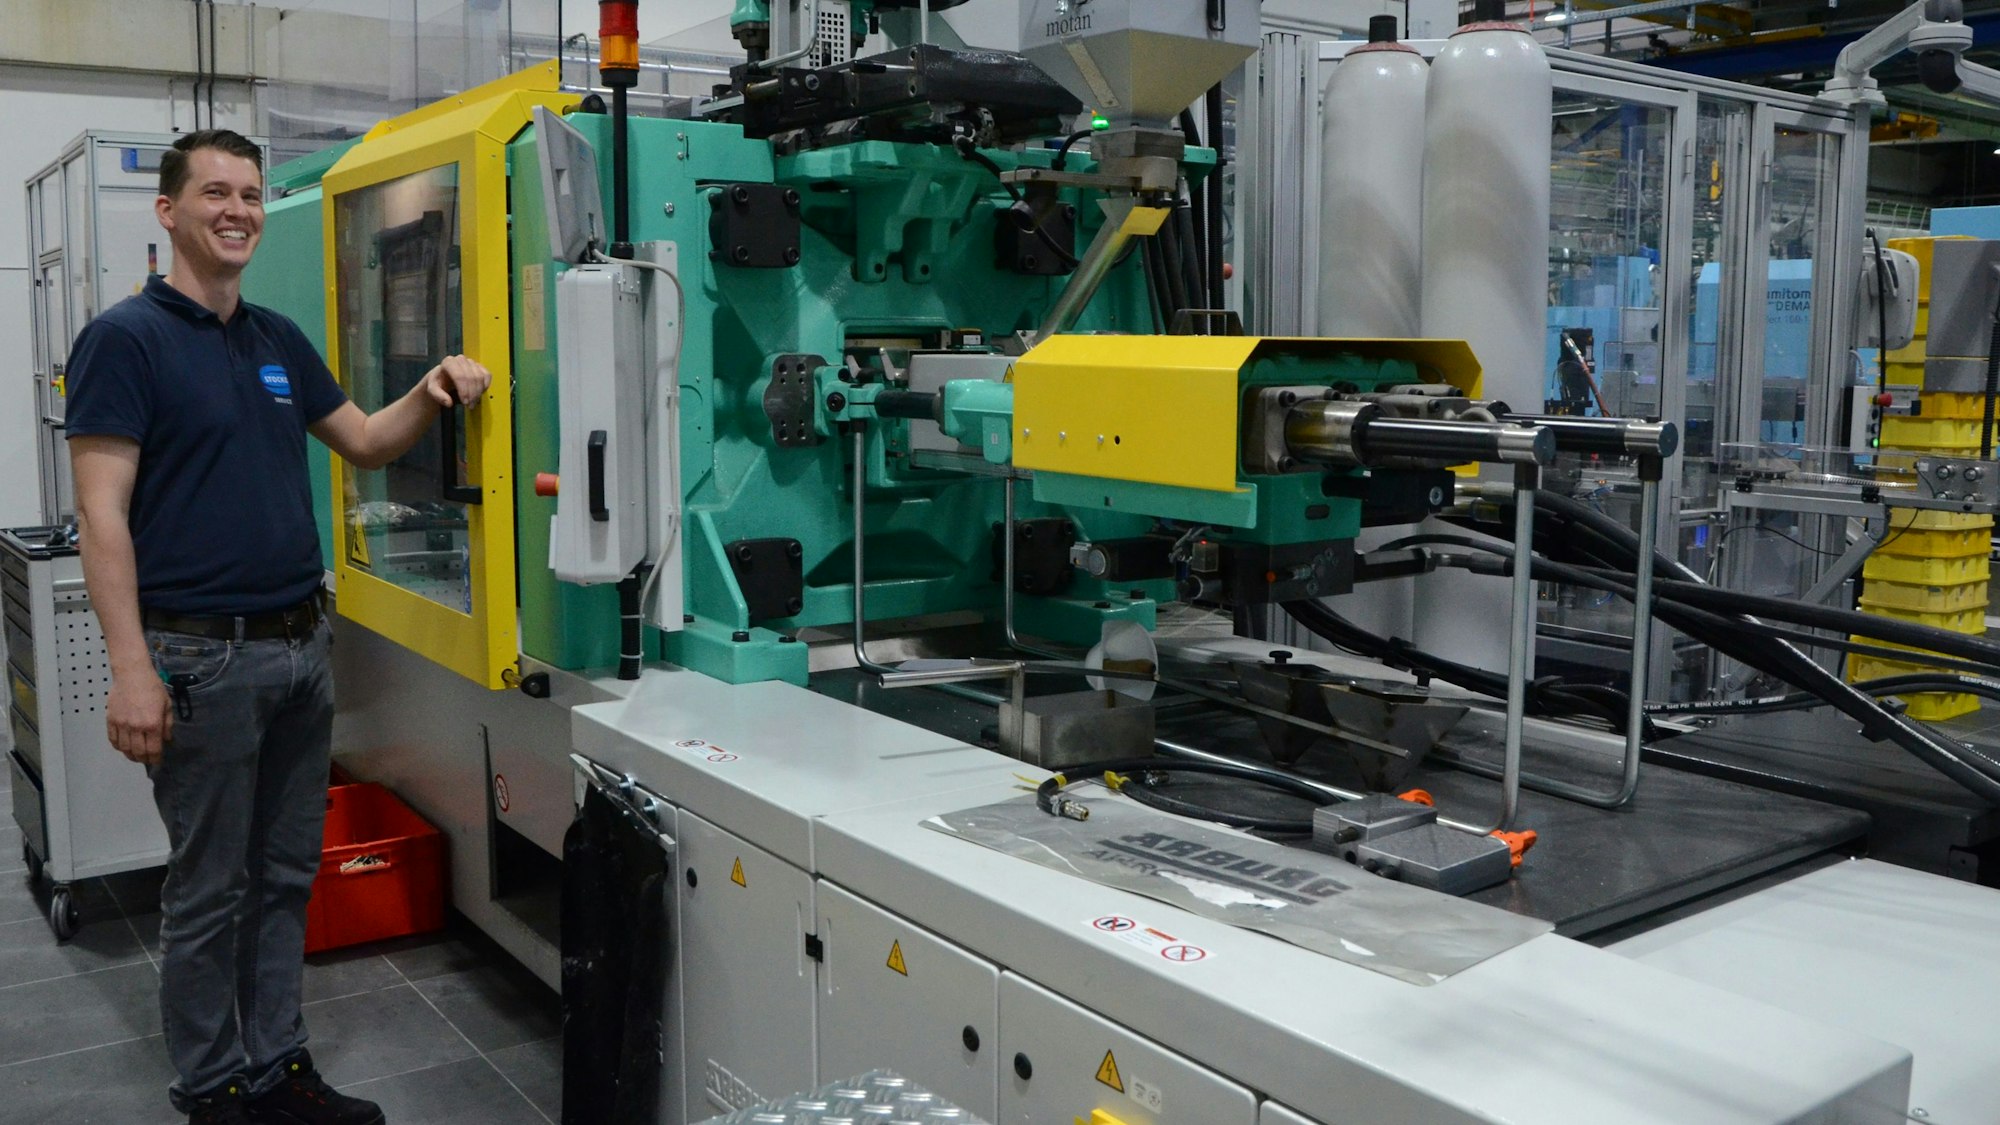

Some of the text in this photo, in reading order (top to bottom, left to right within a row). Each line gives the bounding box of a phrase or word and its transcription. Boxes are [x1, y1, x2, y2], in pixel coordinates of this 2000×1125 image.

[1046, 14, 1091, 36] motan
[1767, 287, 1811, 300] mitom
[1776, 300, 1810, 311] DEMA
[1121, 832, 1352, 898] ARBURG
